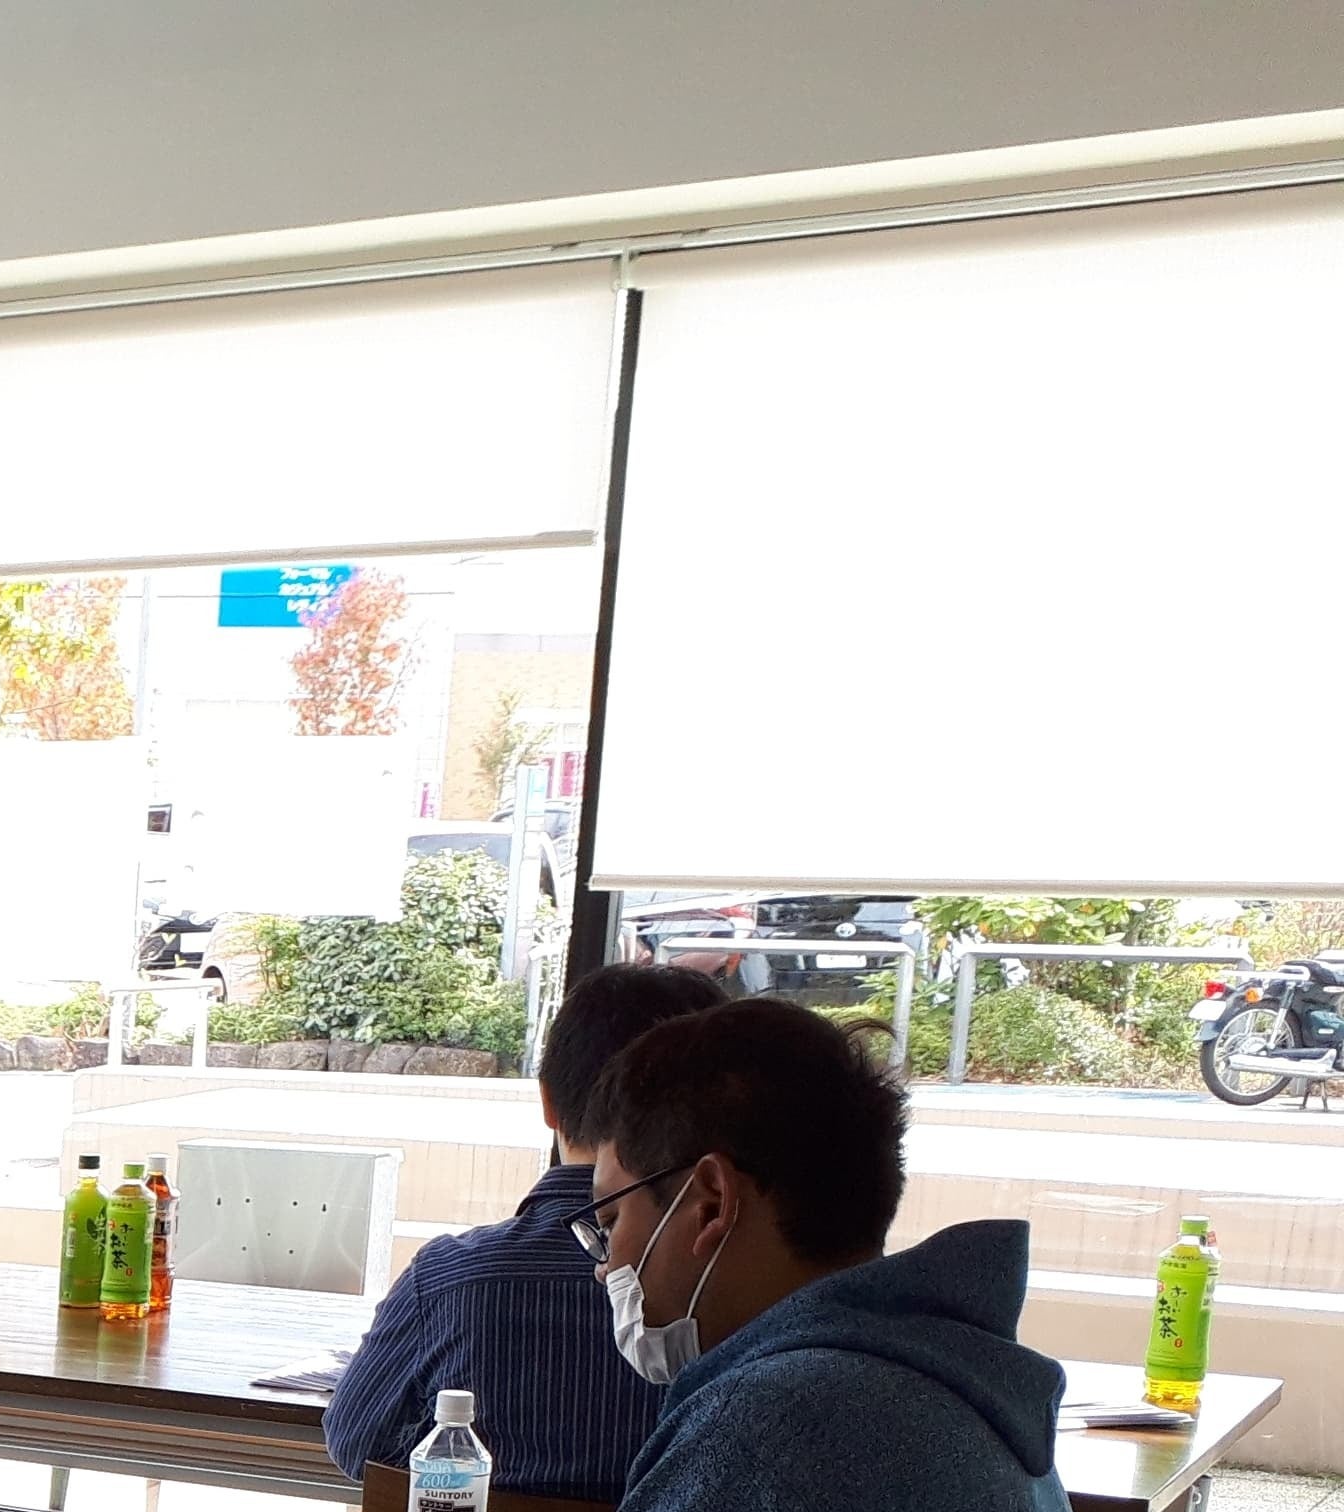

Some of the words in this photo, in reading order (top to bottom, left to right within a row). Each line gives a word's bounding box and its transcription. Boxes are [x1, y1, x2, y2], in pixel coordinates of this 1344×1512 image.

[1157, 1296, 1179, 1339] お茶
[422, 1473, 451, 1488] 600
[425, 1490, 474, 1501] SUNTORY
